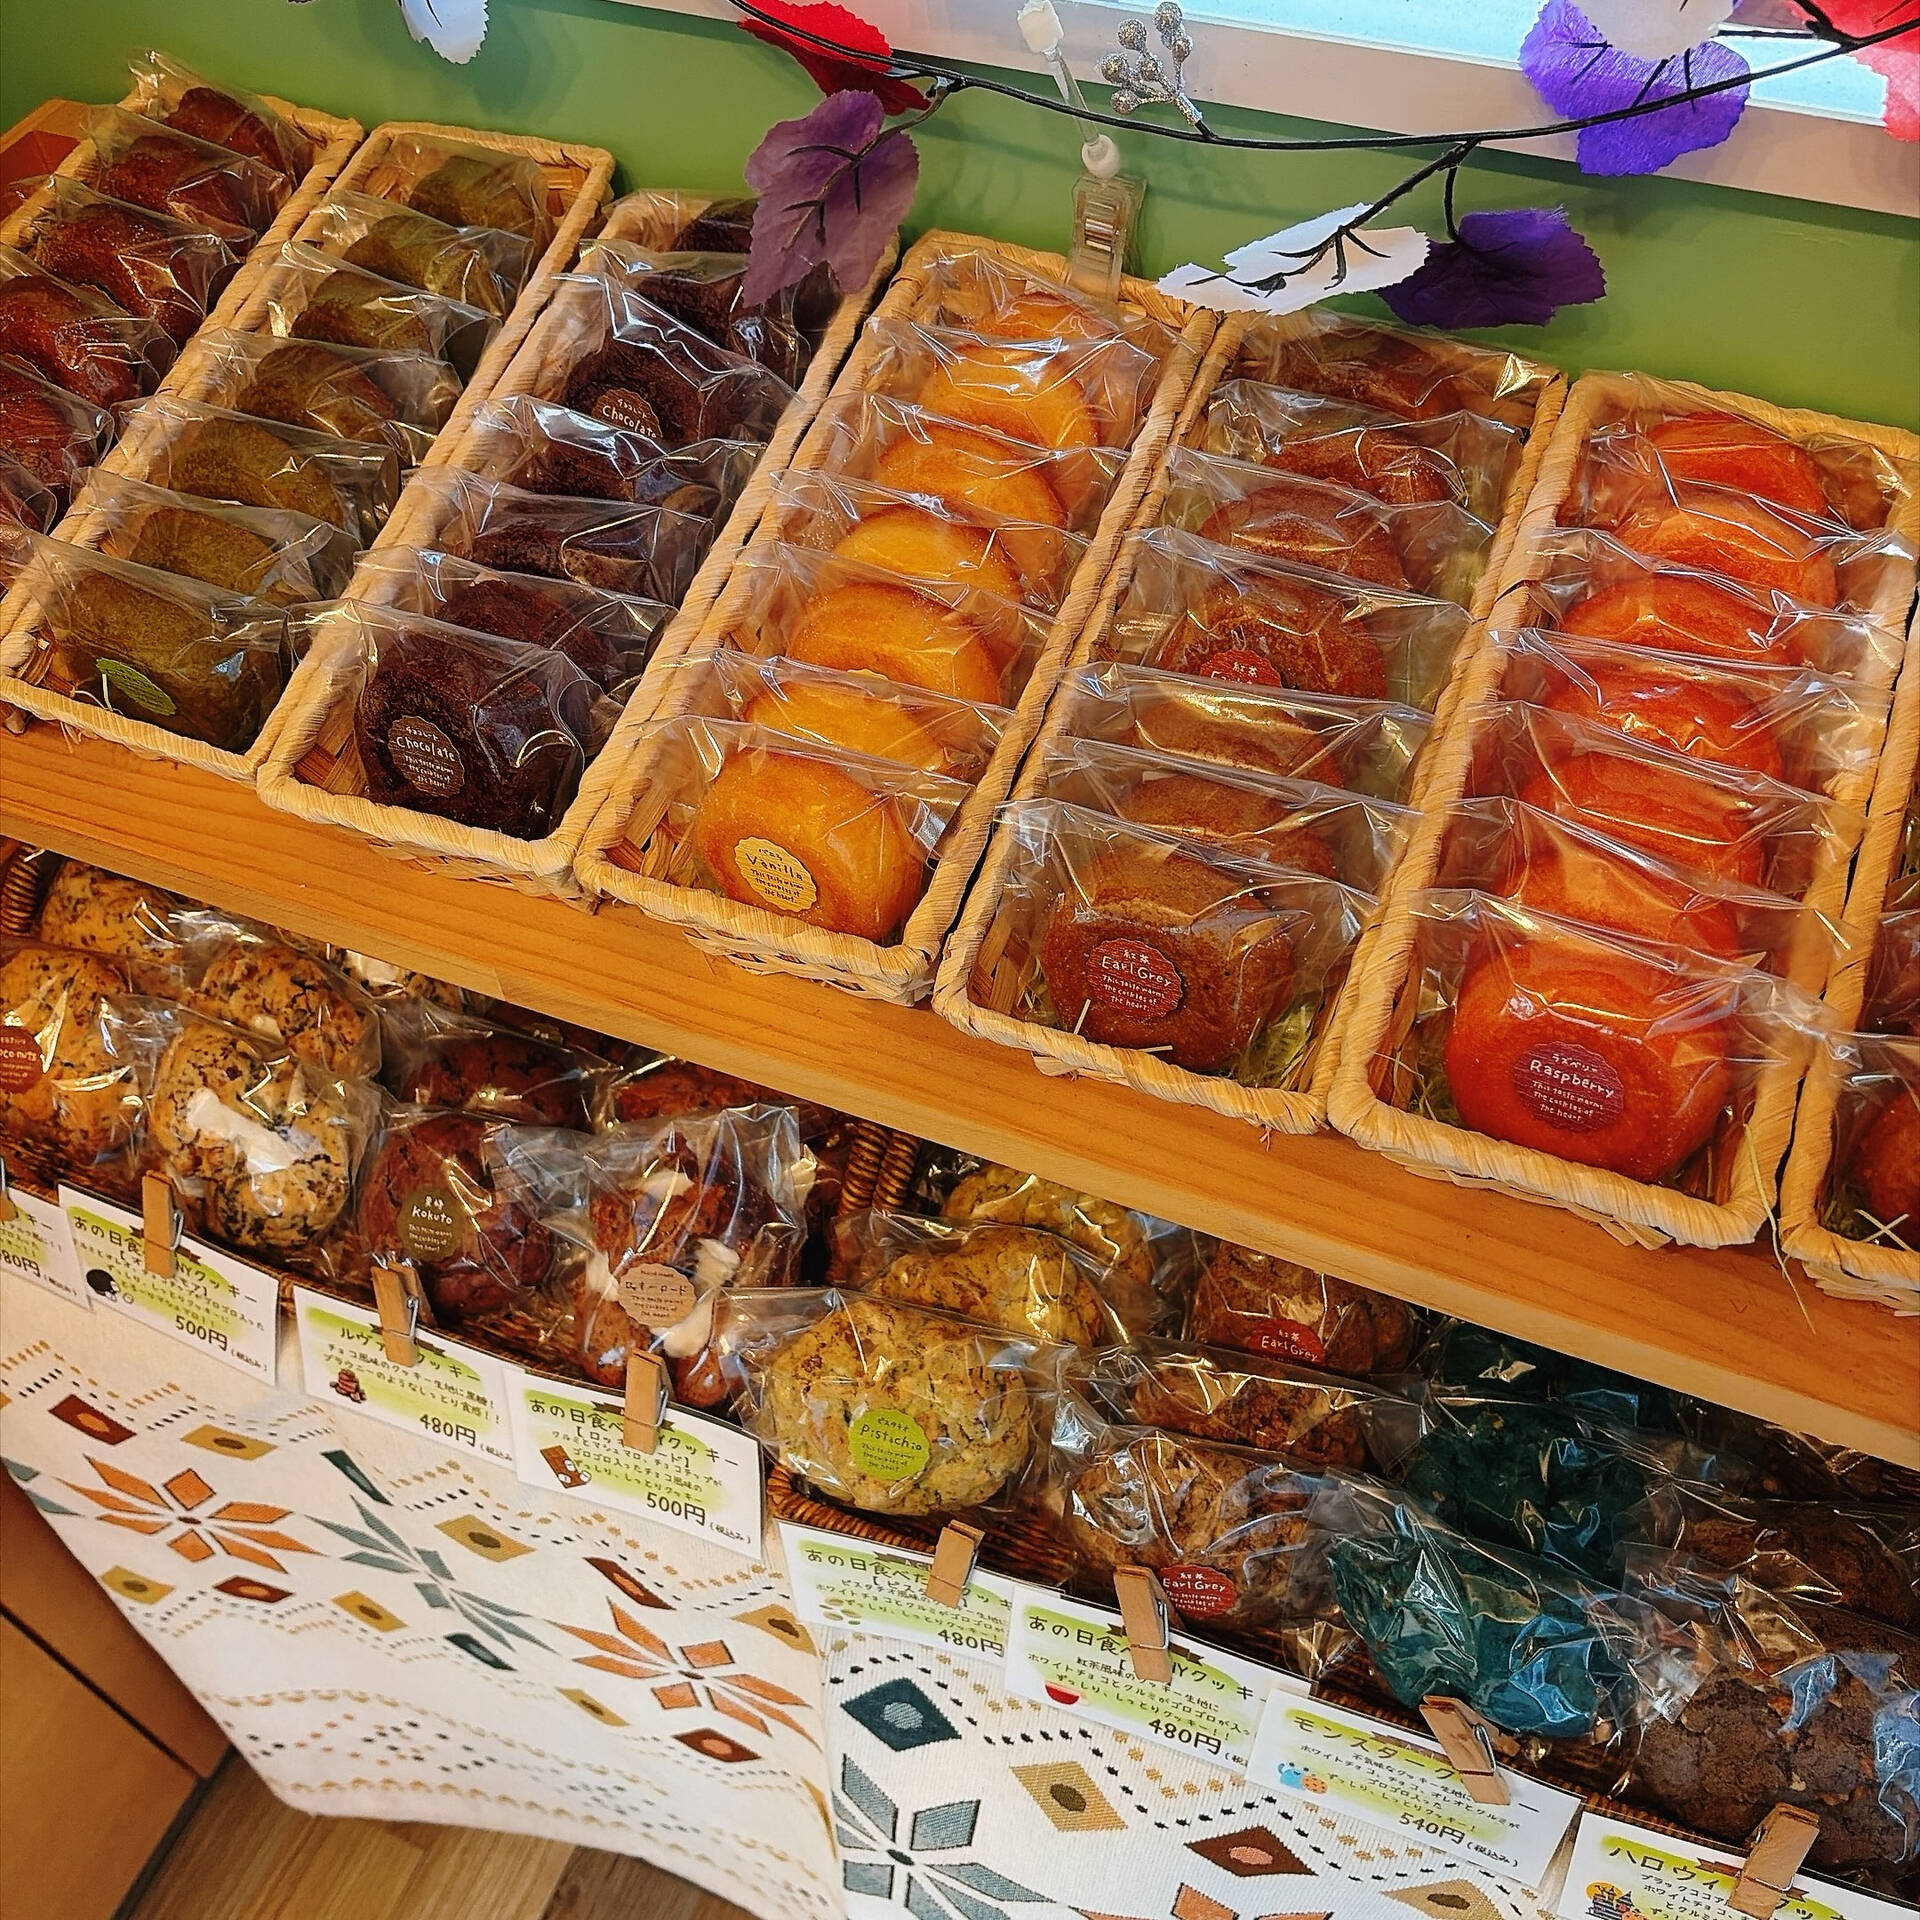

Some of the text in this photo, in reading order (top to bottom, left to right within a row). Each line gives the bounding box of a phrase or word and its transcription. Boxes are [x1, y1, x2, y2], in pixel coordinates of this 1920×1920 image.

[602, 405, 657, 438] Chocolate
[1232, 661, 1258, 678] 紅茶
[396, 736, 456, 762] Chocolate
[745, 852, 803, 881] Vanilla
[1102, 955, 1172, 987] Earl Grey
[1123, 949, 1149, 964] 紅茶
[1529, 1059, 1614, 1098] Raspberry
[1552, 1053, 1598, 1073] ラズベリー
[411, 1205, 453, 1225] Kokuto
[0, 1249, 40, 1278] 80円
[74, 1216, 257, 1303] あの日食NYクッキー
[175, 1314, 228, 1351] 500円
[1261, 1335, 1318, 1362] Earl Grey
[341, 1327, 481, 1382] ルヴァクッキー
[419, 1413, 476, 1448] 480円
[576, 1426, 690, 1468] 【ロッキード】
[646, 1492, 706, 1527] 500円
[1162, 1577, 1226, 1592] Earl Grey
[938, 1628, 1005, 1658] 480円
[1148, 1718, 1222, 1756] 480円
[1293, 1715, 1540, 1813] モンスタークー
[1398, 1811, 1466, 1846] 540円
[1641, 1873, 1728, 1907] ブラックココア
